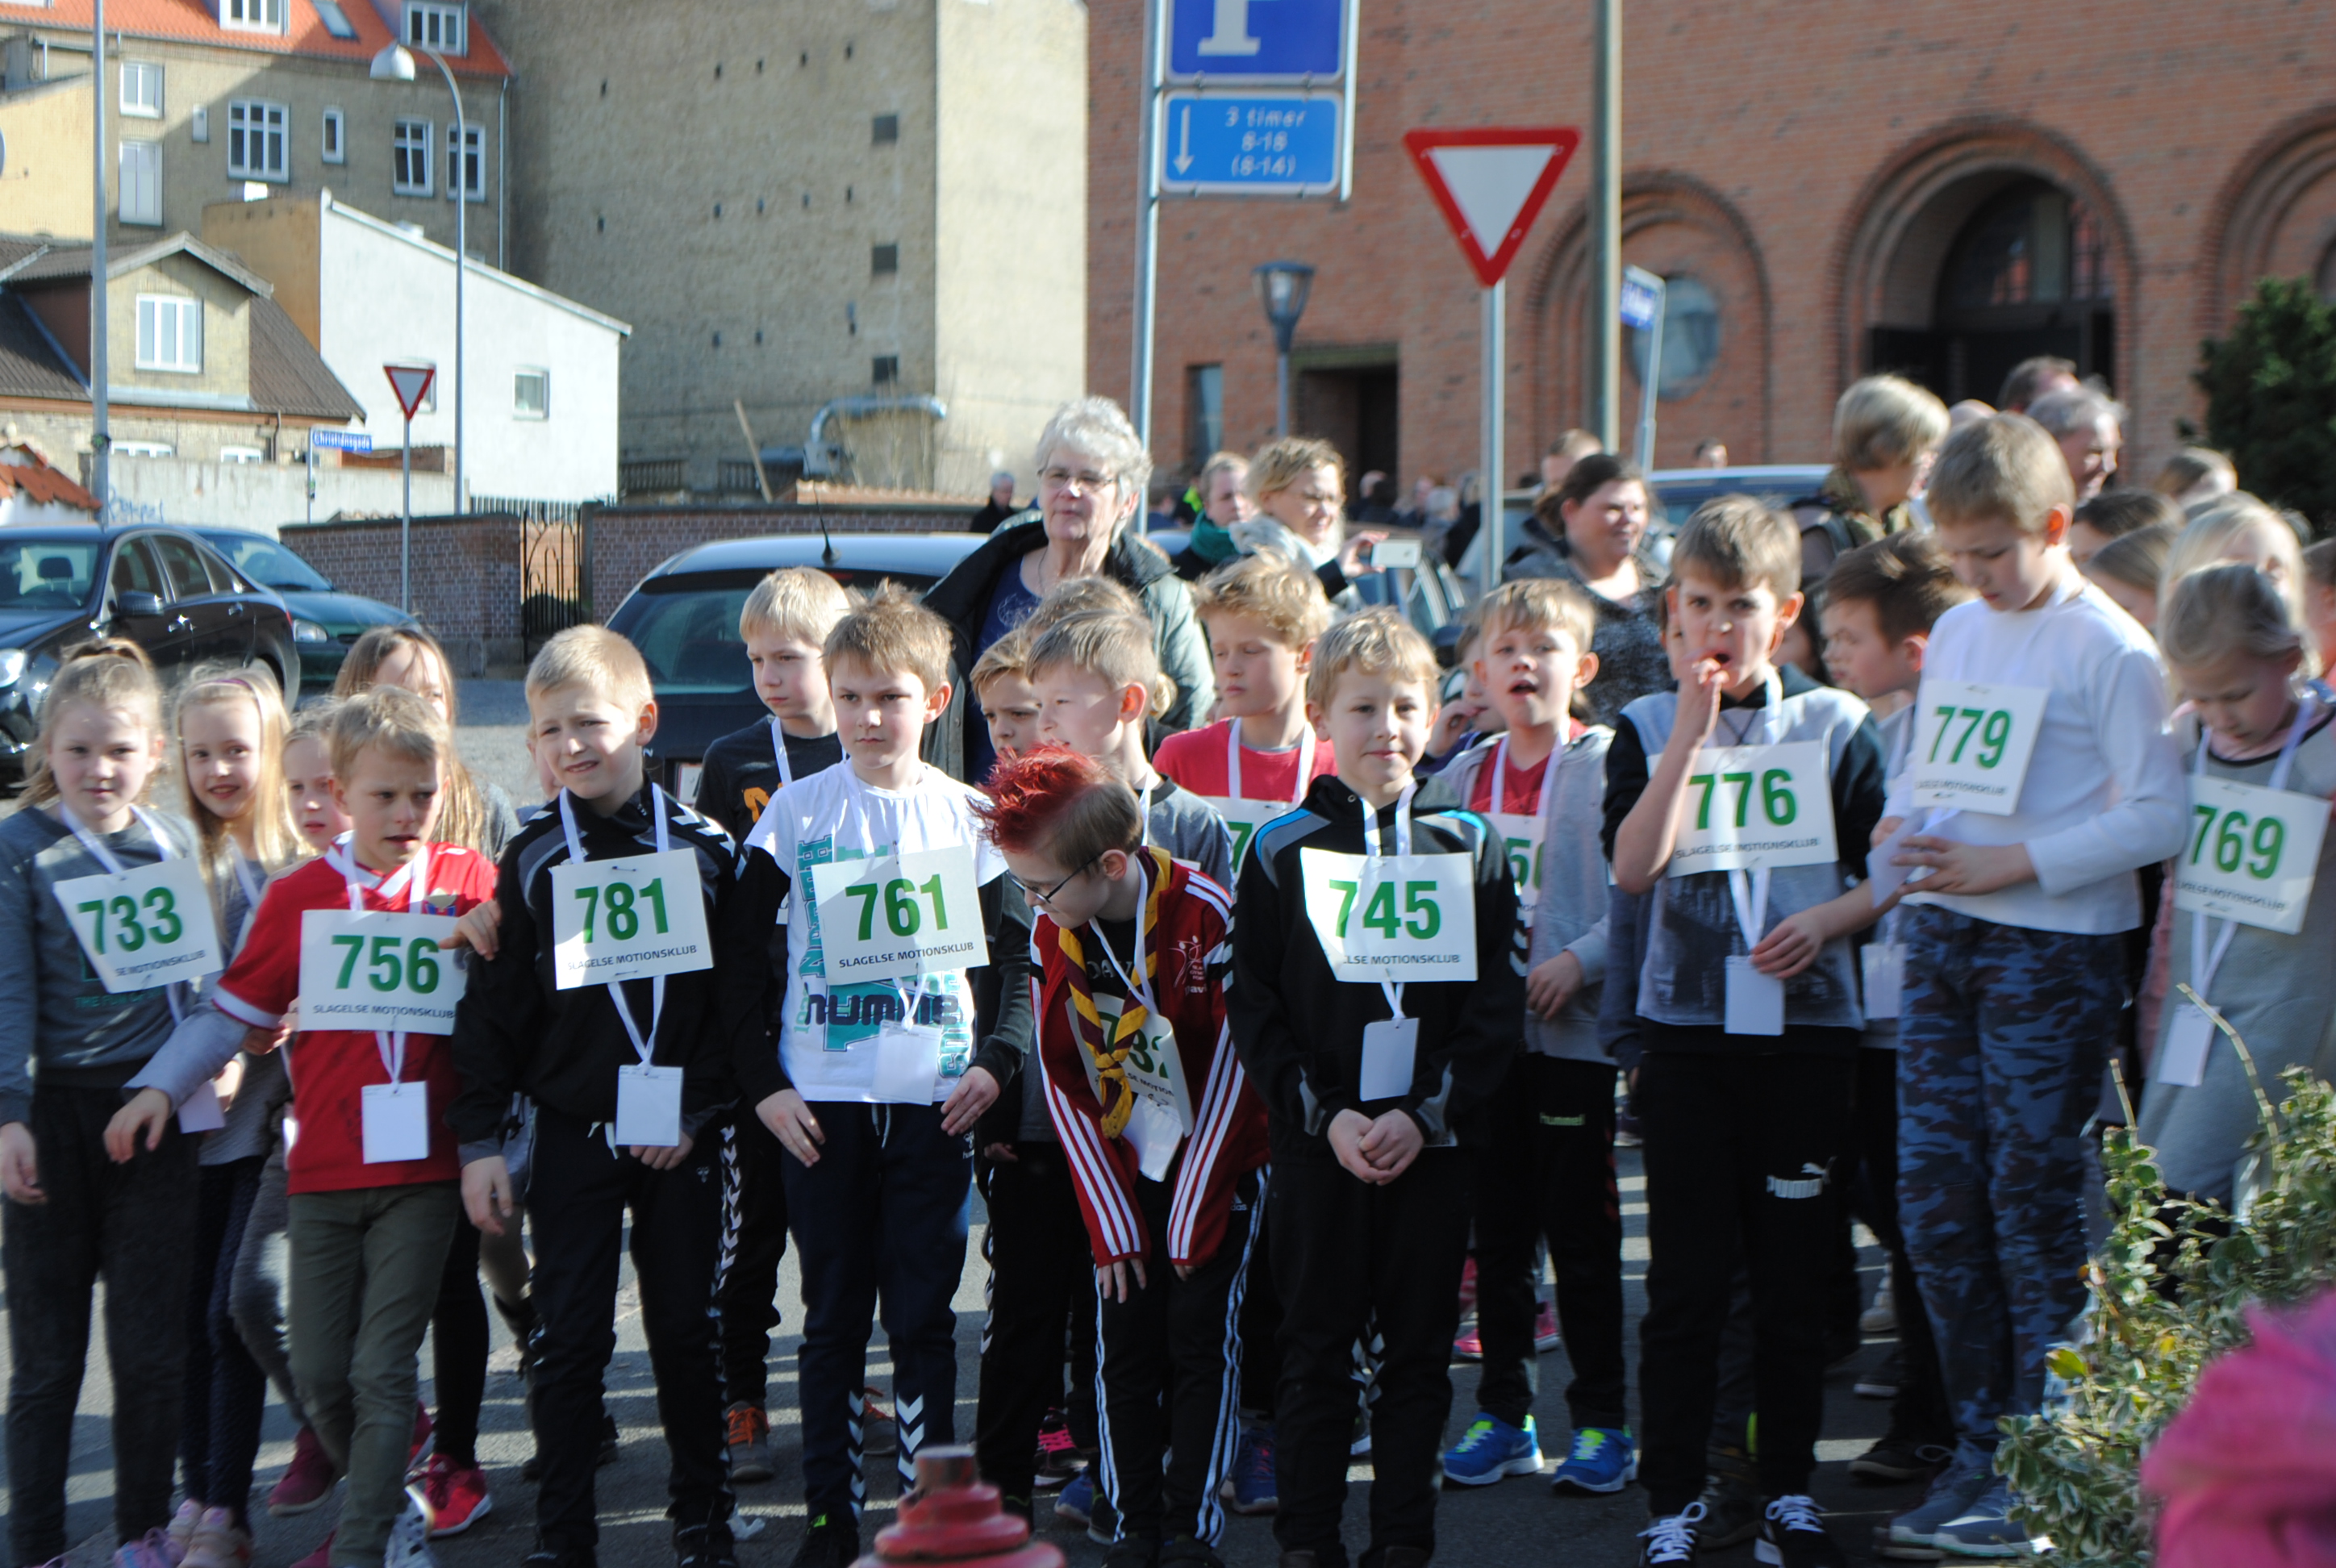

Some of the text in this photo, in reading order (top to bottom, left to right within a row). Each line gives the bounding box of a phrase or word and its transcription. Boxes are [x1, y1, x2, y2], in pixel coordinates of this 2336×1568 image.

[1224, 106, 1308, 127] 3 timer
[1241, 131, 1288, 152] 8-18
[1231, 155, 1297, 177] (8-14)
[1927, 705, 2013, 771] 779
[1687, 768, 1798, 831] 776
[1675, 837, 1820, 859] SLAGELSE MOTIONSKLUB
[2189, 803, 2288, 881] 769
[77, 886, 183, 956] 733
[574, 877, 669, 945] 781
[845, 874, 948, 941] 761
[1329, 879, 1441, 940] 745
[128, 949, 206, 974] MOTIONSKLUB
[332, 934, 440, 994] 756
[567, 945, 697, 971] SLAGELSE MOTIONSKLUB
[839, 941, 974, 969] SLAGELSE MOTIONSKLUB
[1370, 954, 1461, 965] MOTIONSKLUB
[313, 1004, 455, 1018] SLAGELSE MOTIONSKLUB
